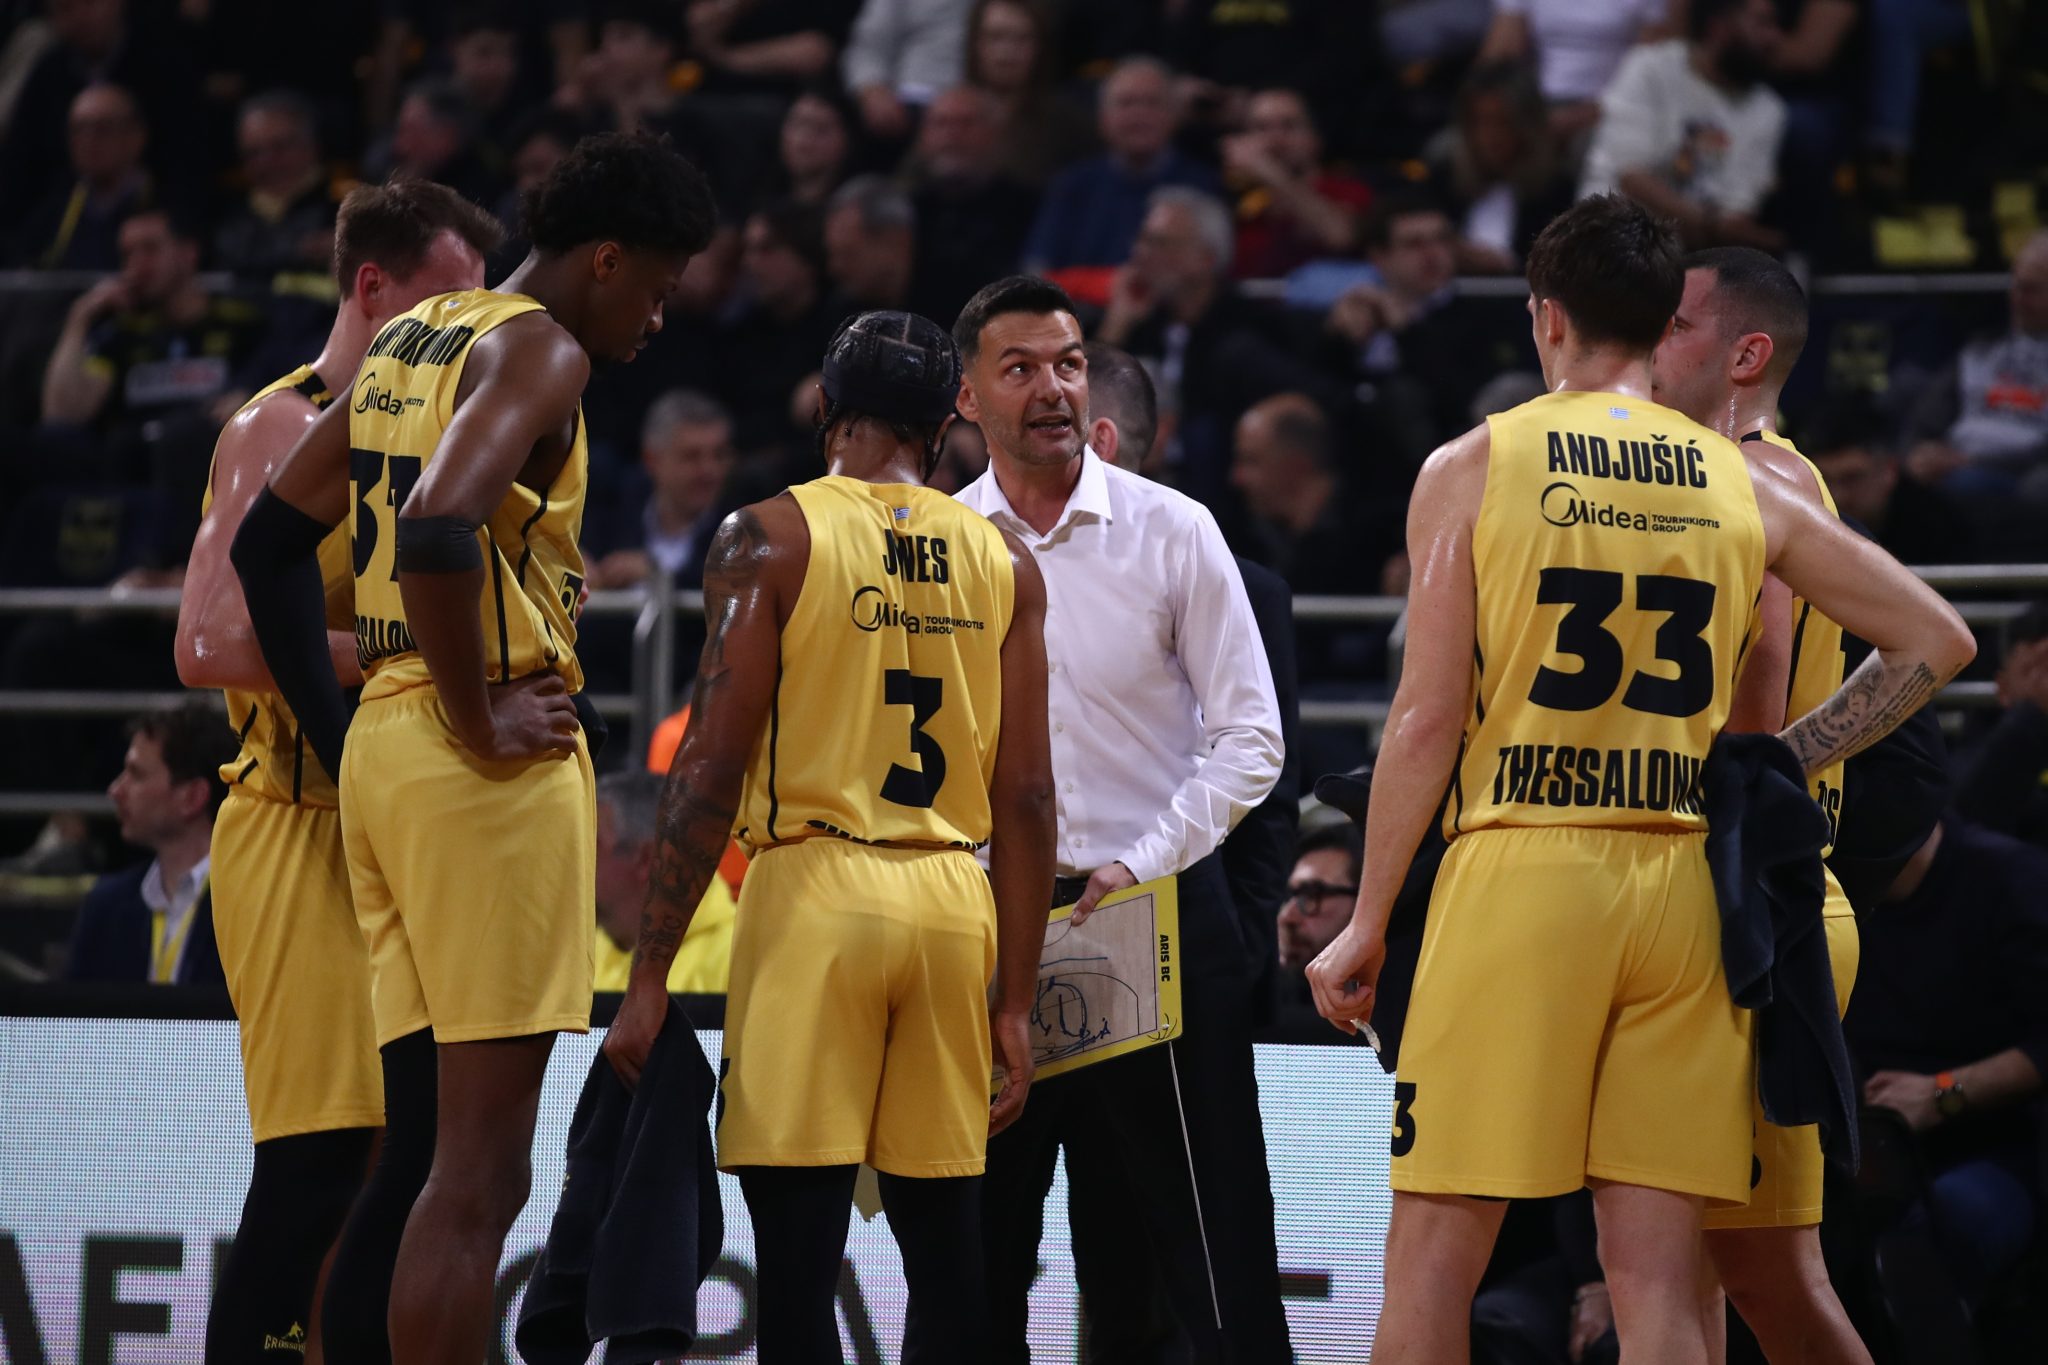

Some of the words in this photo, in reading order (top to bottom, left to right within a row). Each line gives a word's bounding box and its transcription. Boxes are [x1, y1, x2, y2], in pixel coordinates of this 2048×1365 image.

[354, 371, 403, 417] Mida
[1547, 431, 1708, 489] ANDJUŠIĆ
[1541, 481, 1648, 531] Midea
[1651, 514, 1720, 529] TOURNIKIOTIS
[1651, 524, 1687, 533] GROUP
[882, 528, 949, 584] JNES
[925, 626, 953, 635] GROU
[1527, 567, 1717, 718] 33
[879, 669, 946, 808] 3
[1159, 934, 1170, 963] ARIS
[1161, 966, 1171, 982] BC
